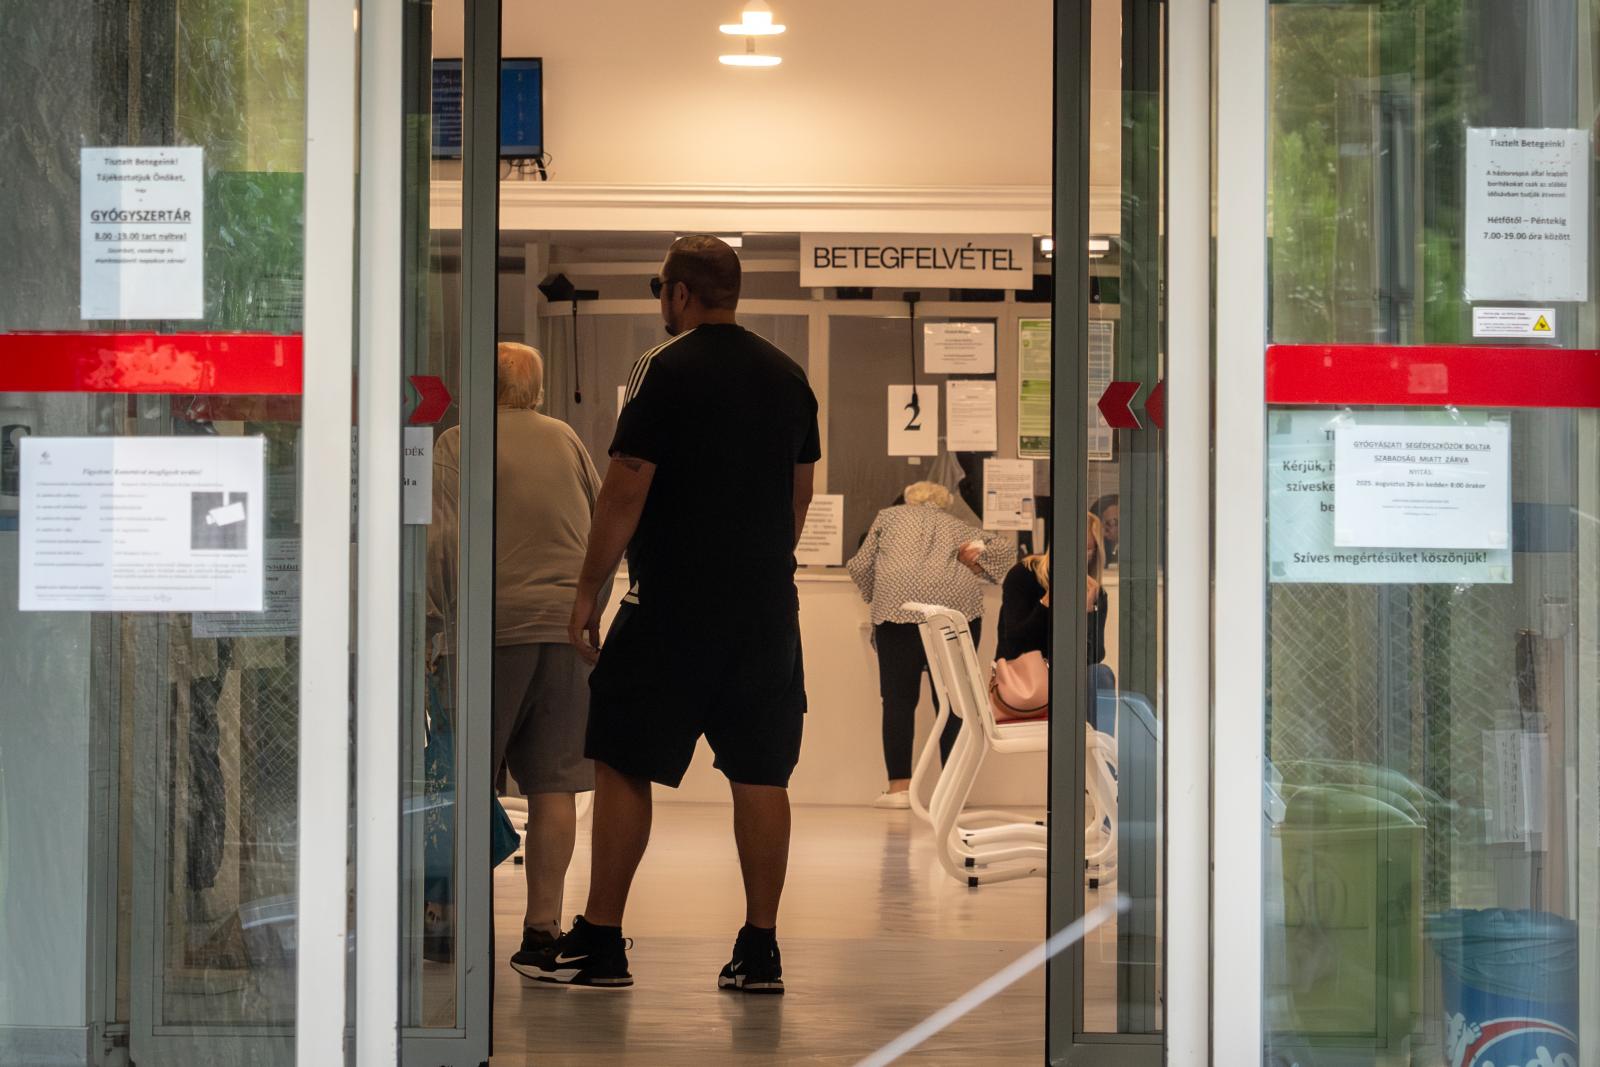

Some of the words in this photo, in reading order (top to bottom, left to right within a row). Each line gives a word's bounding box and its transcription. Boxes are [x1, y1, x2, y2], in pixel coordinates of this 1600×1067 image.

[1490, 139, 1519, 148] Tisztelt
[1521, 140, 1565, 149] Betegeink!
[90, 208, 192, 222] GYÓGYSZERTÁR
[1530, 217, 1567, 226] Péntekig
[1528, 232, 1542, 240] óra
[1544, 232, 1571, 240] között
[813, 243, 1023, 271] BETEGFELVÉTEL
[904, 402, 921, 431] 2
[1283, 460, 1326, 474] Kérjük,
[1293, 552, 1330, 564] Szíves
[1333, 552, 1418, 566] megértésüket
[1421, 552, 1488, 566] köszönjük!
